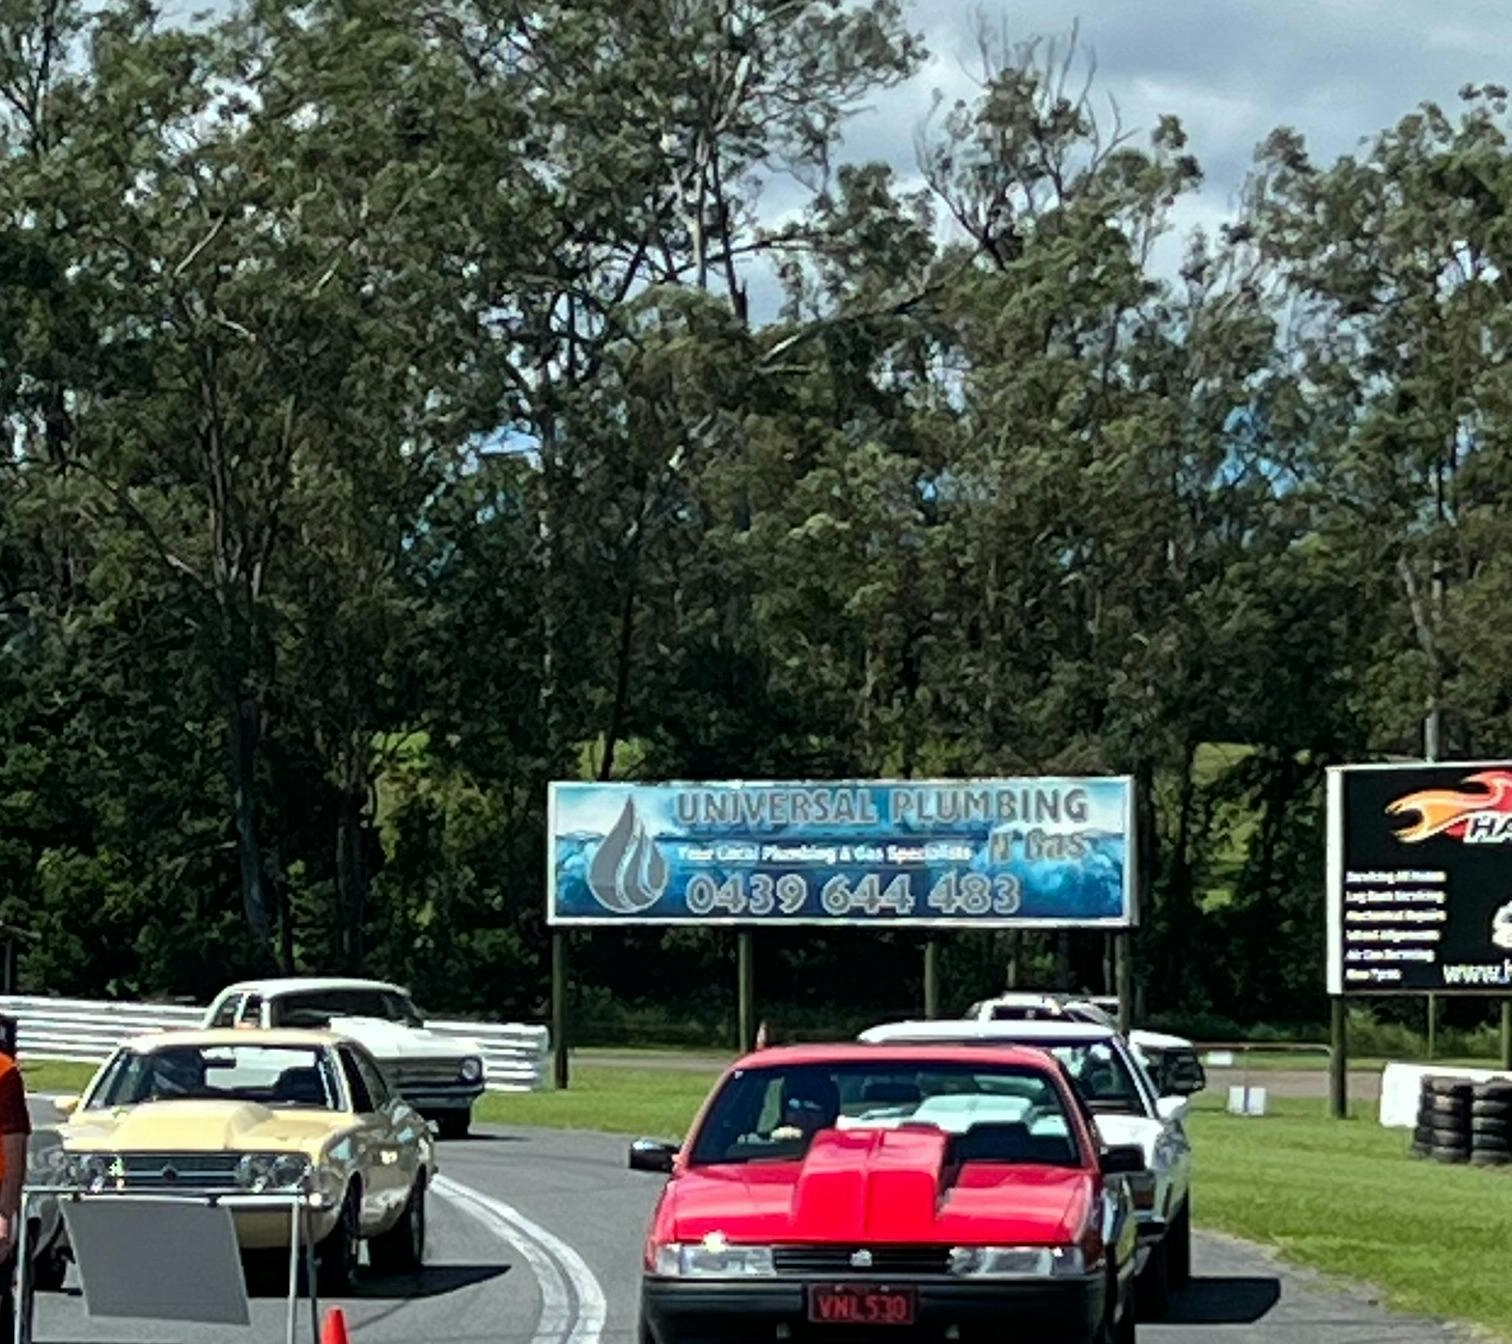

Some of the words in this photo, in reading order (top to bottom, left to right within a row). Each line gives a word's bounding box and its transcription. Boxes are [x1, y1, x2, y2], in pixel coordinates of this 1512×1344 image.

[677, 788, 878, 825] UNIVERSAL
[890, 786, 1090, 825] PLUMBING
[678, 845, 714, 861] Your
[716, 844, 758, 862] Local
[762, 844, 836, 865] Plumbing
[854, 845, 884, 861] Gas
[686, 872, 807, 915] 0439
[820, 872, 916, 916] 644
[927, 872, 1021, 915] 483
